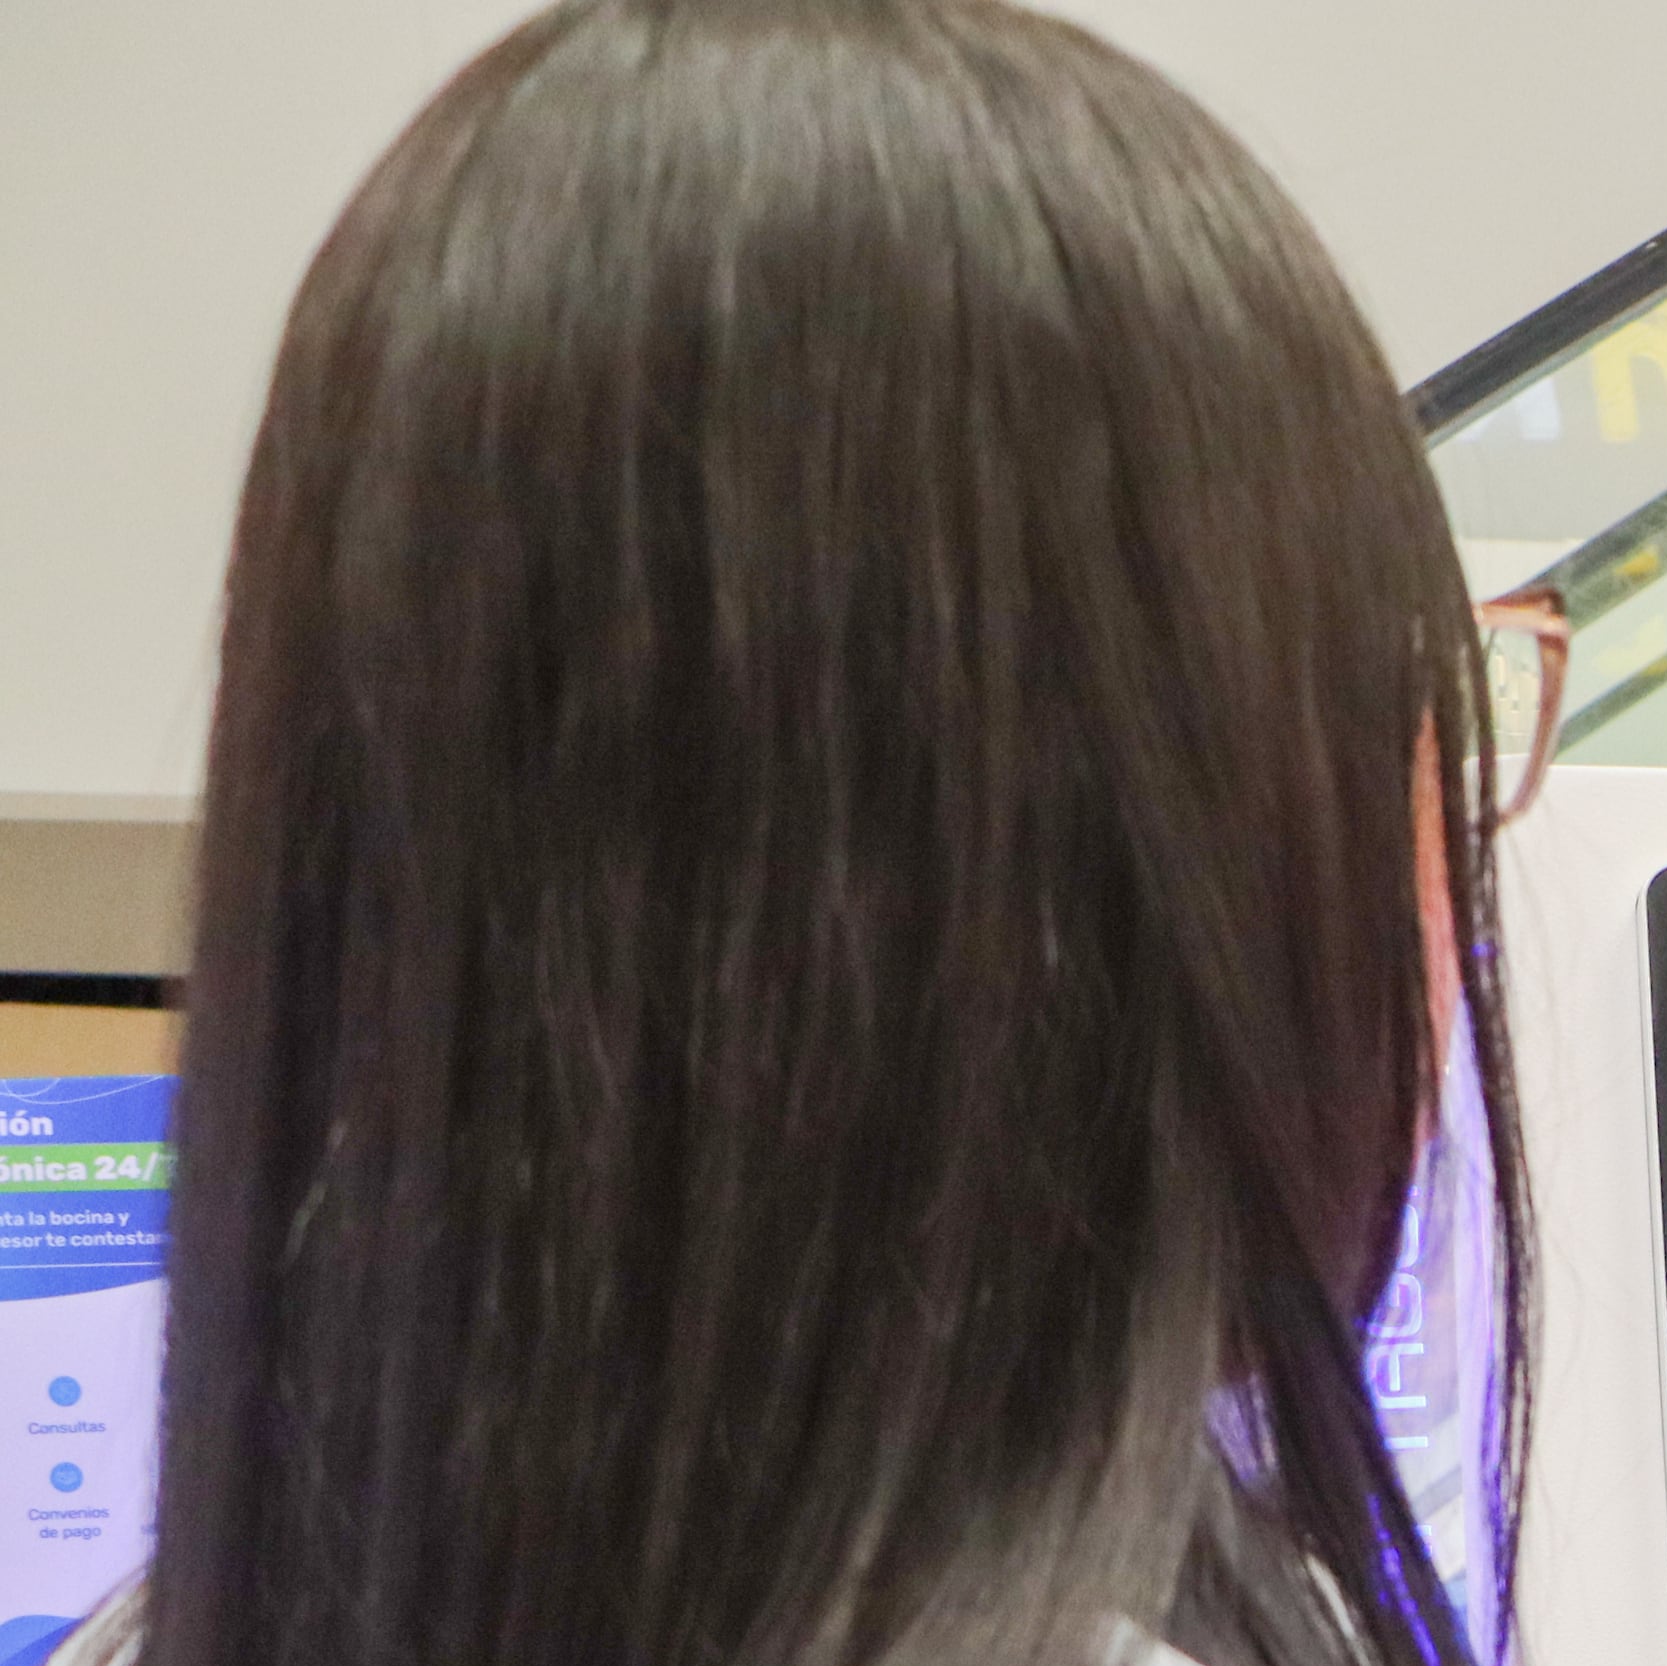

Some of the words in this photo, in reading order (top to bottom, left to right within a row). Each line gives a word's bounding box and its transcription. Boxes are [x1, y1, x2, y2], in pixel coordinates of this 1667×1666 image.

[28, 1210, 46, 1226] la
[50, 1209, 115, 1225] bocina
[117, 1211, 130, 1228] y
[45, 1231, 66, 1247] te
[27, 1421, 107, 1435] Consultas
[28, 1506, 110, 1521] Convenios
[39, 1526, 58, 1539] de
[62, 1526, 102, 1541] pago
